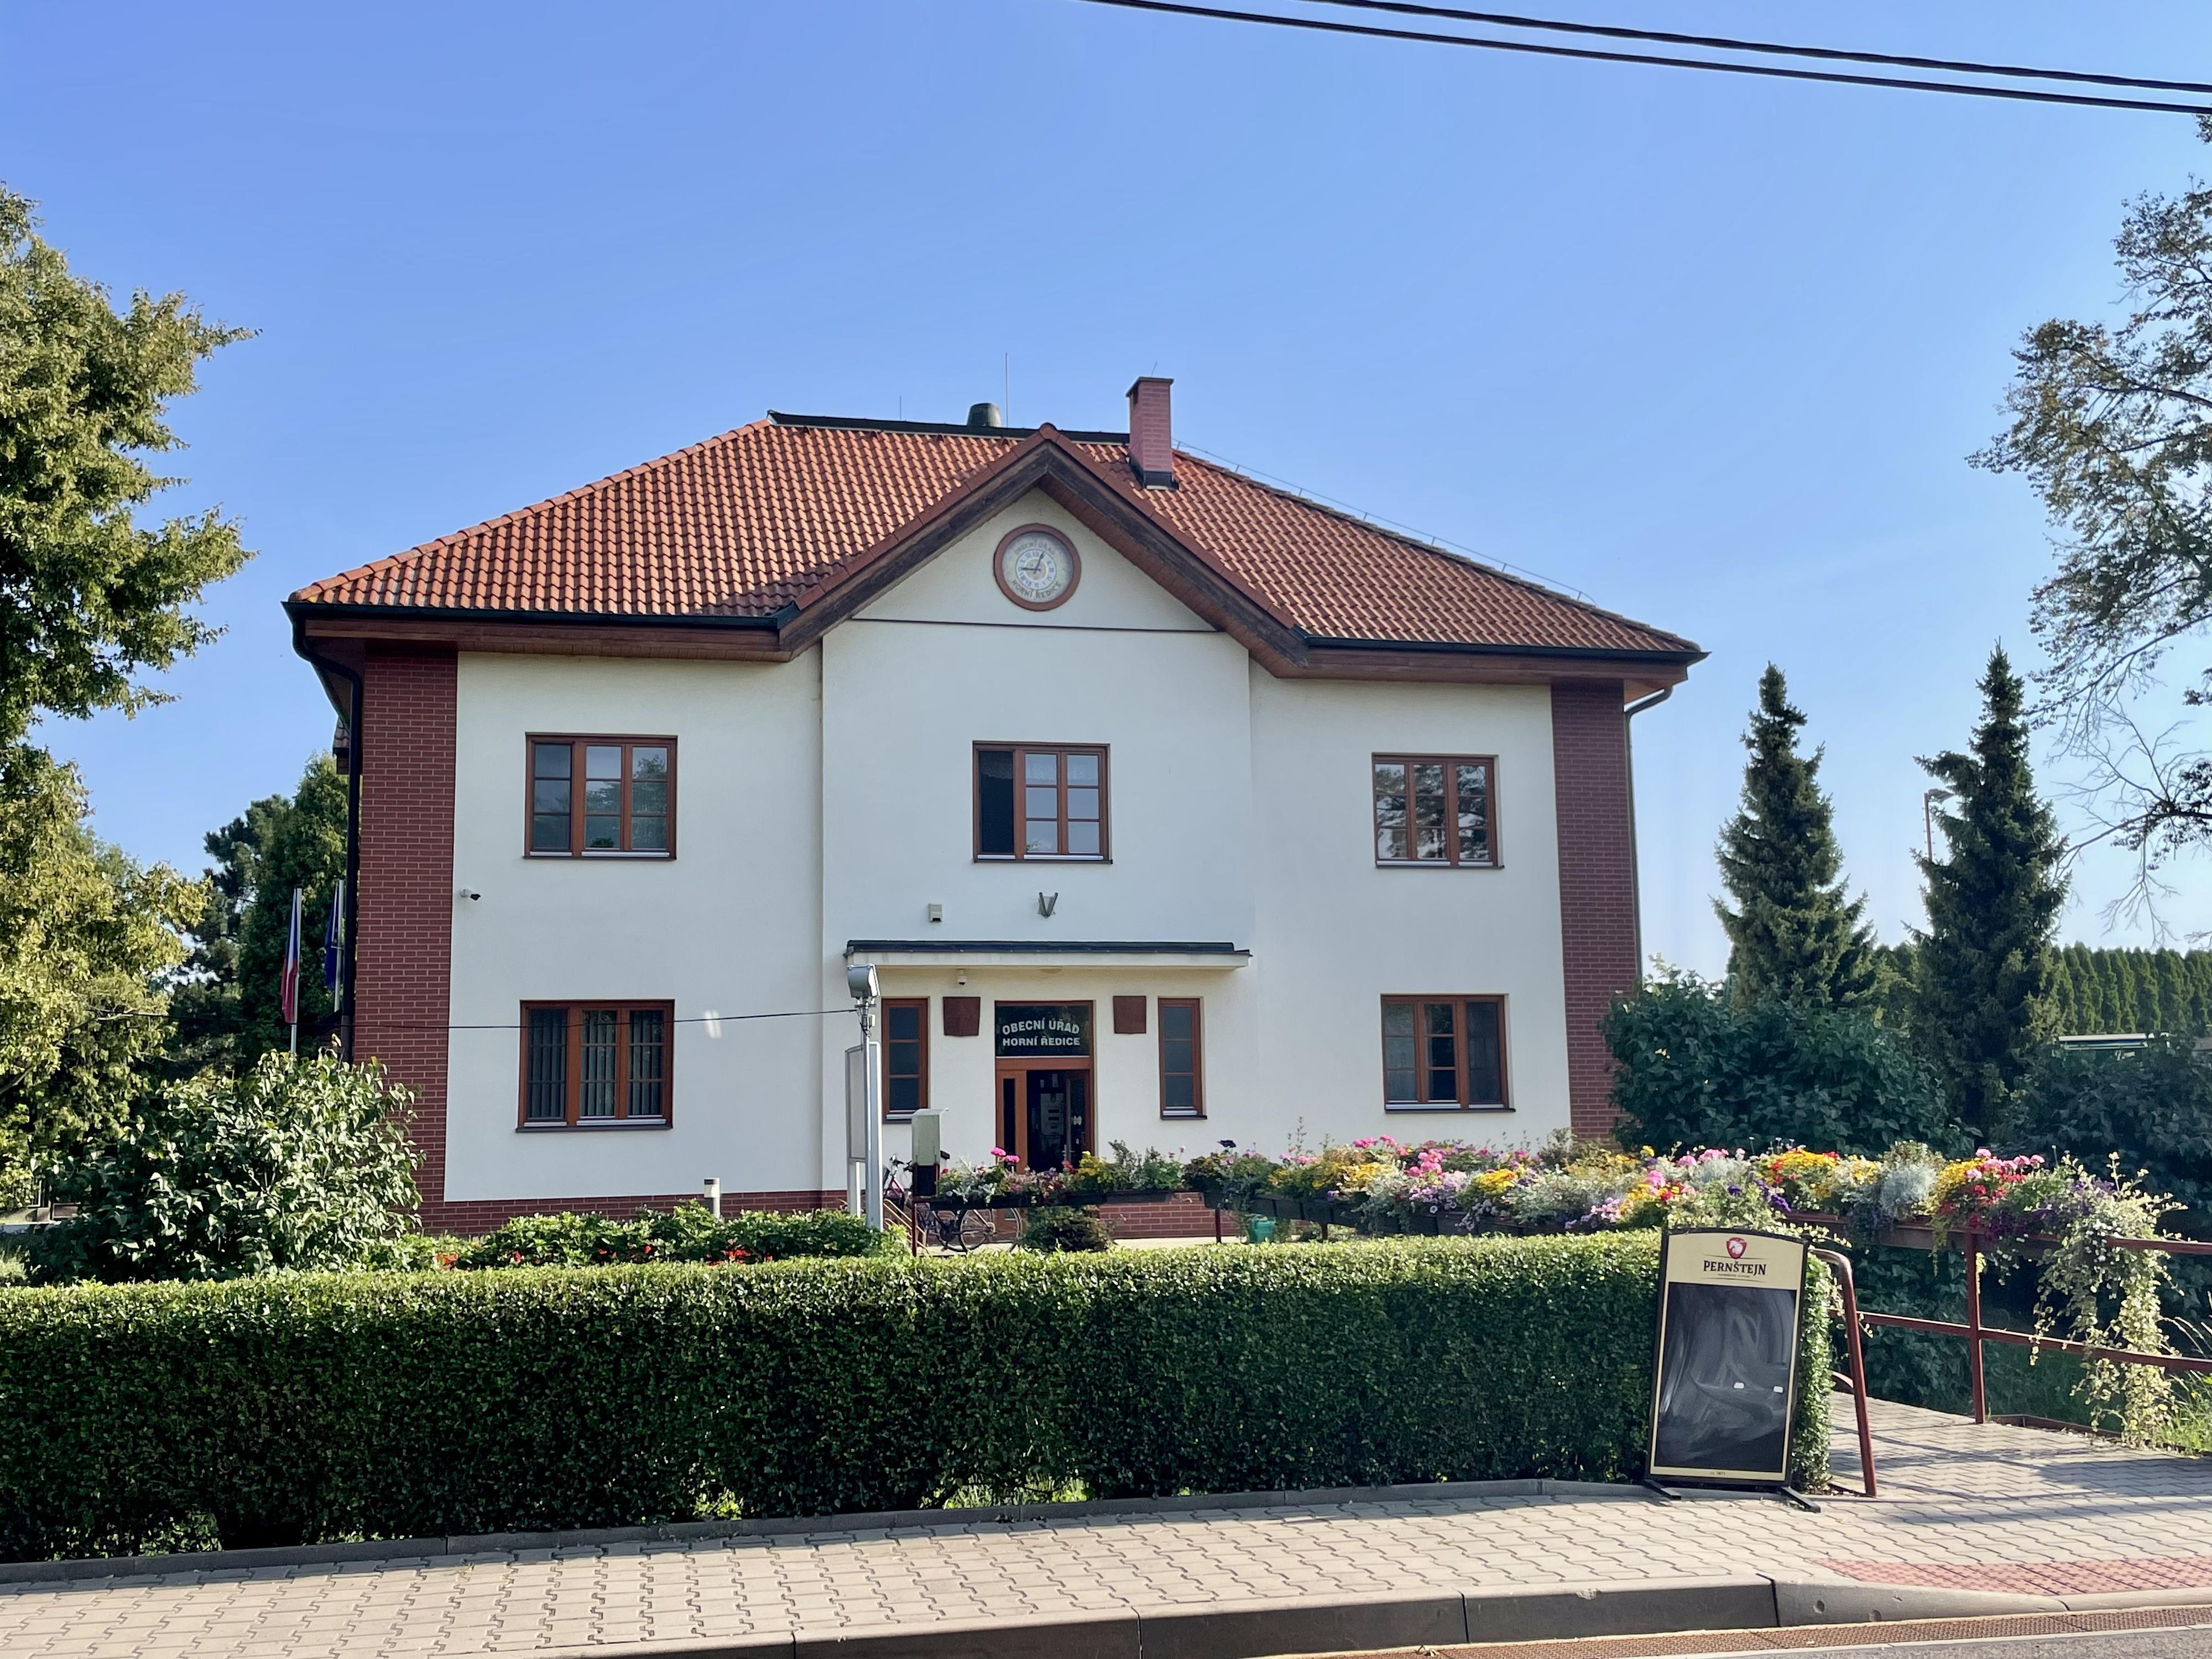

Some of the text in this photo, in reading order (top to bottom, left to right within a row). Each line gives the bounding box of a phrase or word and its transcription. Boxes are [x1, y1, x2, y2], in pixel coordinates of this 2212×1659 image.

[1002, 1017, 1079, 1035] OBECNÍ ÚŘAD
[1003, 1036, 1081, 1046] HORNÍ ŘEDICE
[1703, 1260, 1766, 1276] PERNŠTEJN
